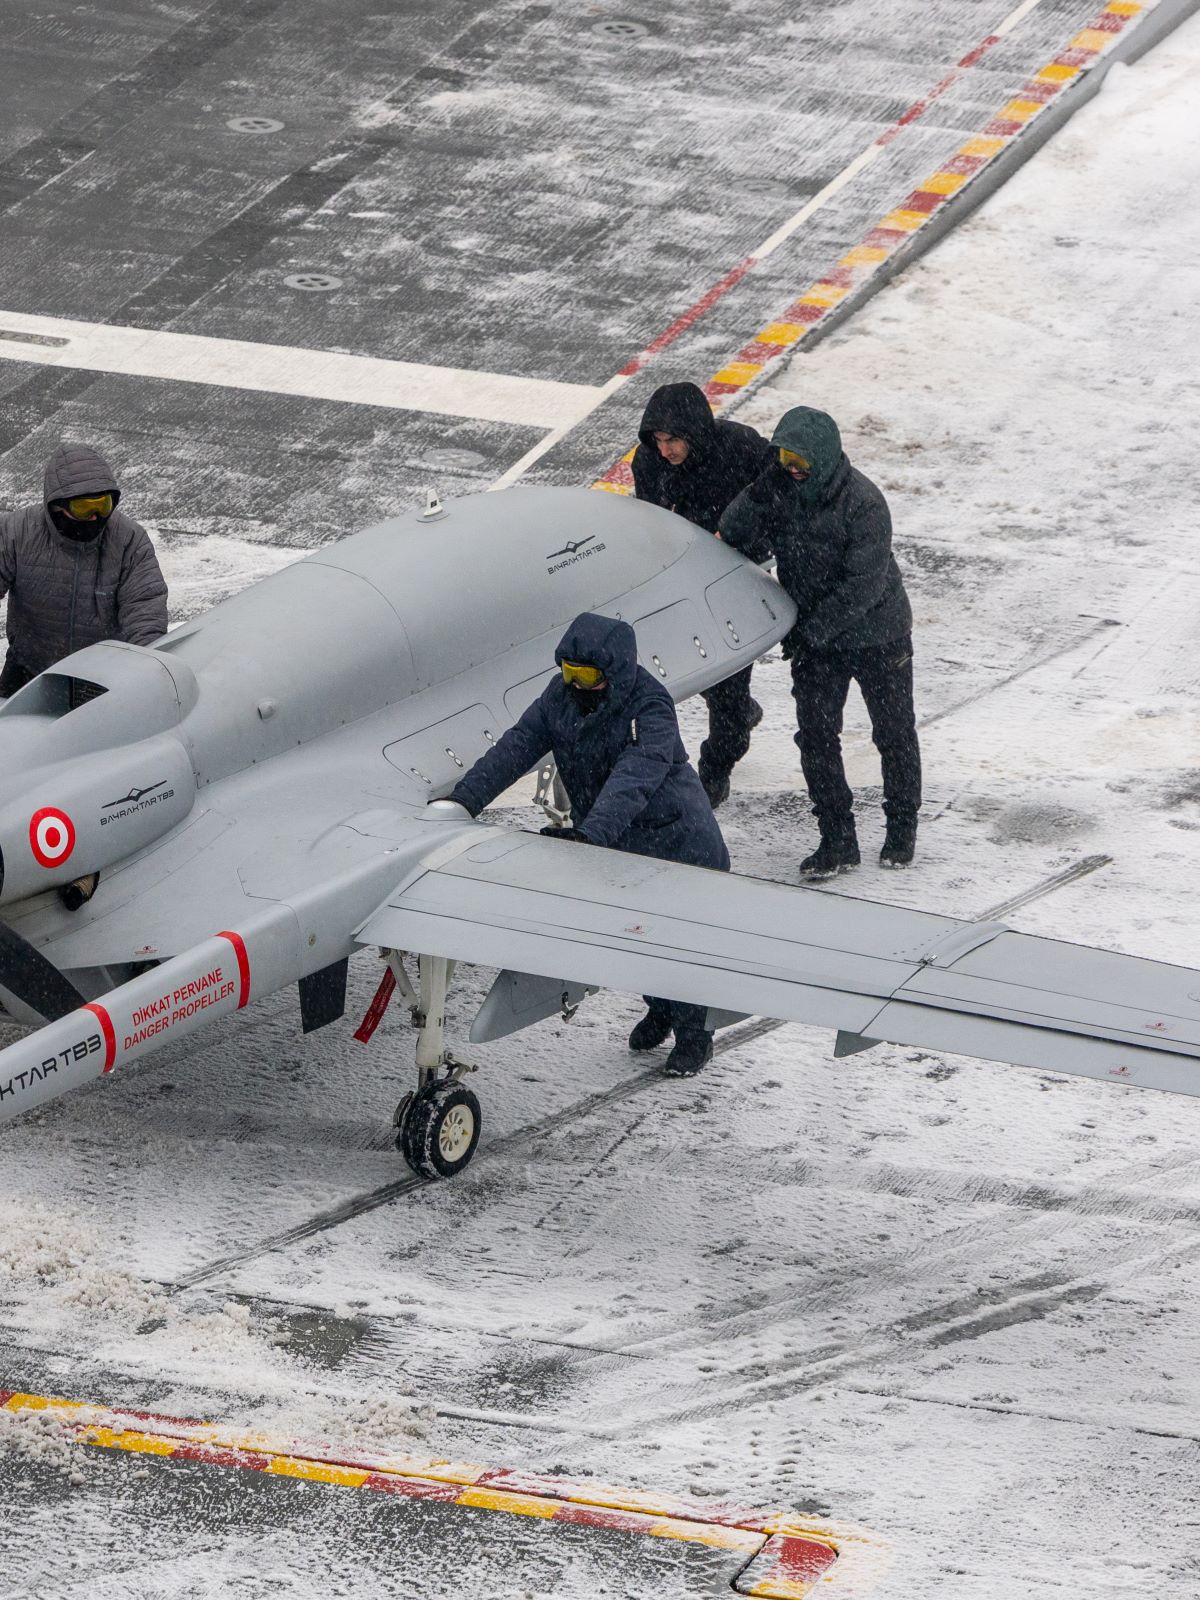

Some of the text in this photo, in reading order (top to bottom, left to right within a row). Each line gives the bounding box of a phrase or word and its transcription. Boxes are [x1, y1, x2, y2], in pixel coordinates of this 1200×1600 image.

[124, 981, 235, 1050] DANGER PROPELLER
[132, 967, 223, 1027] DİKKAT PERVANE
